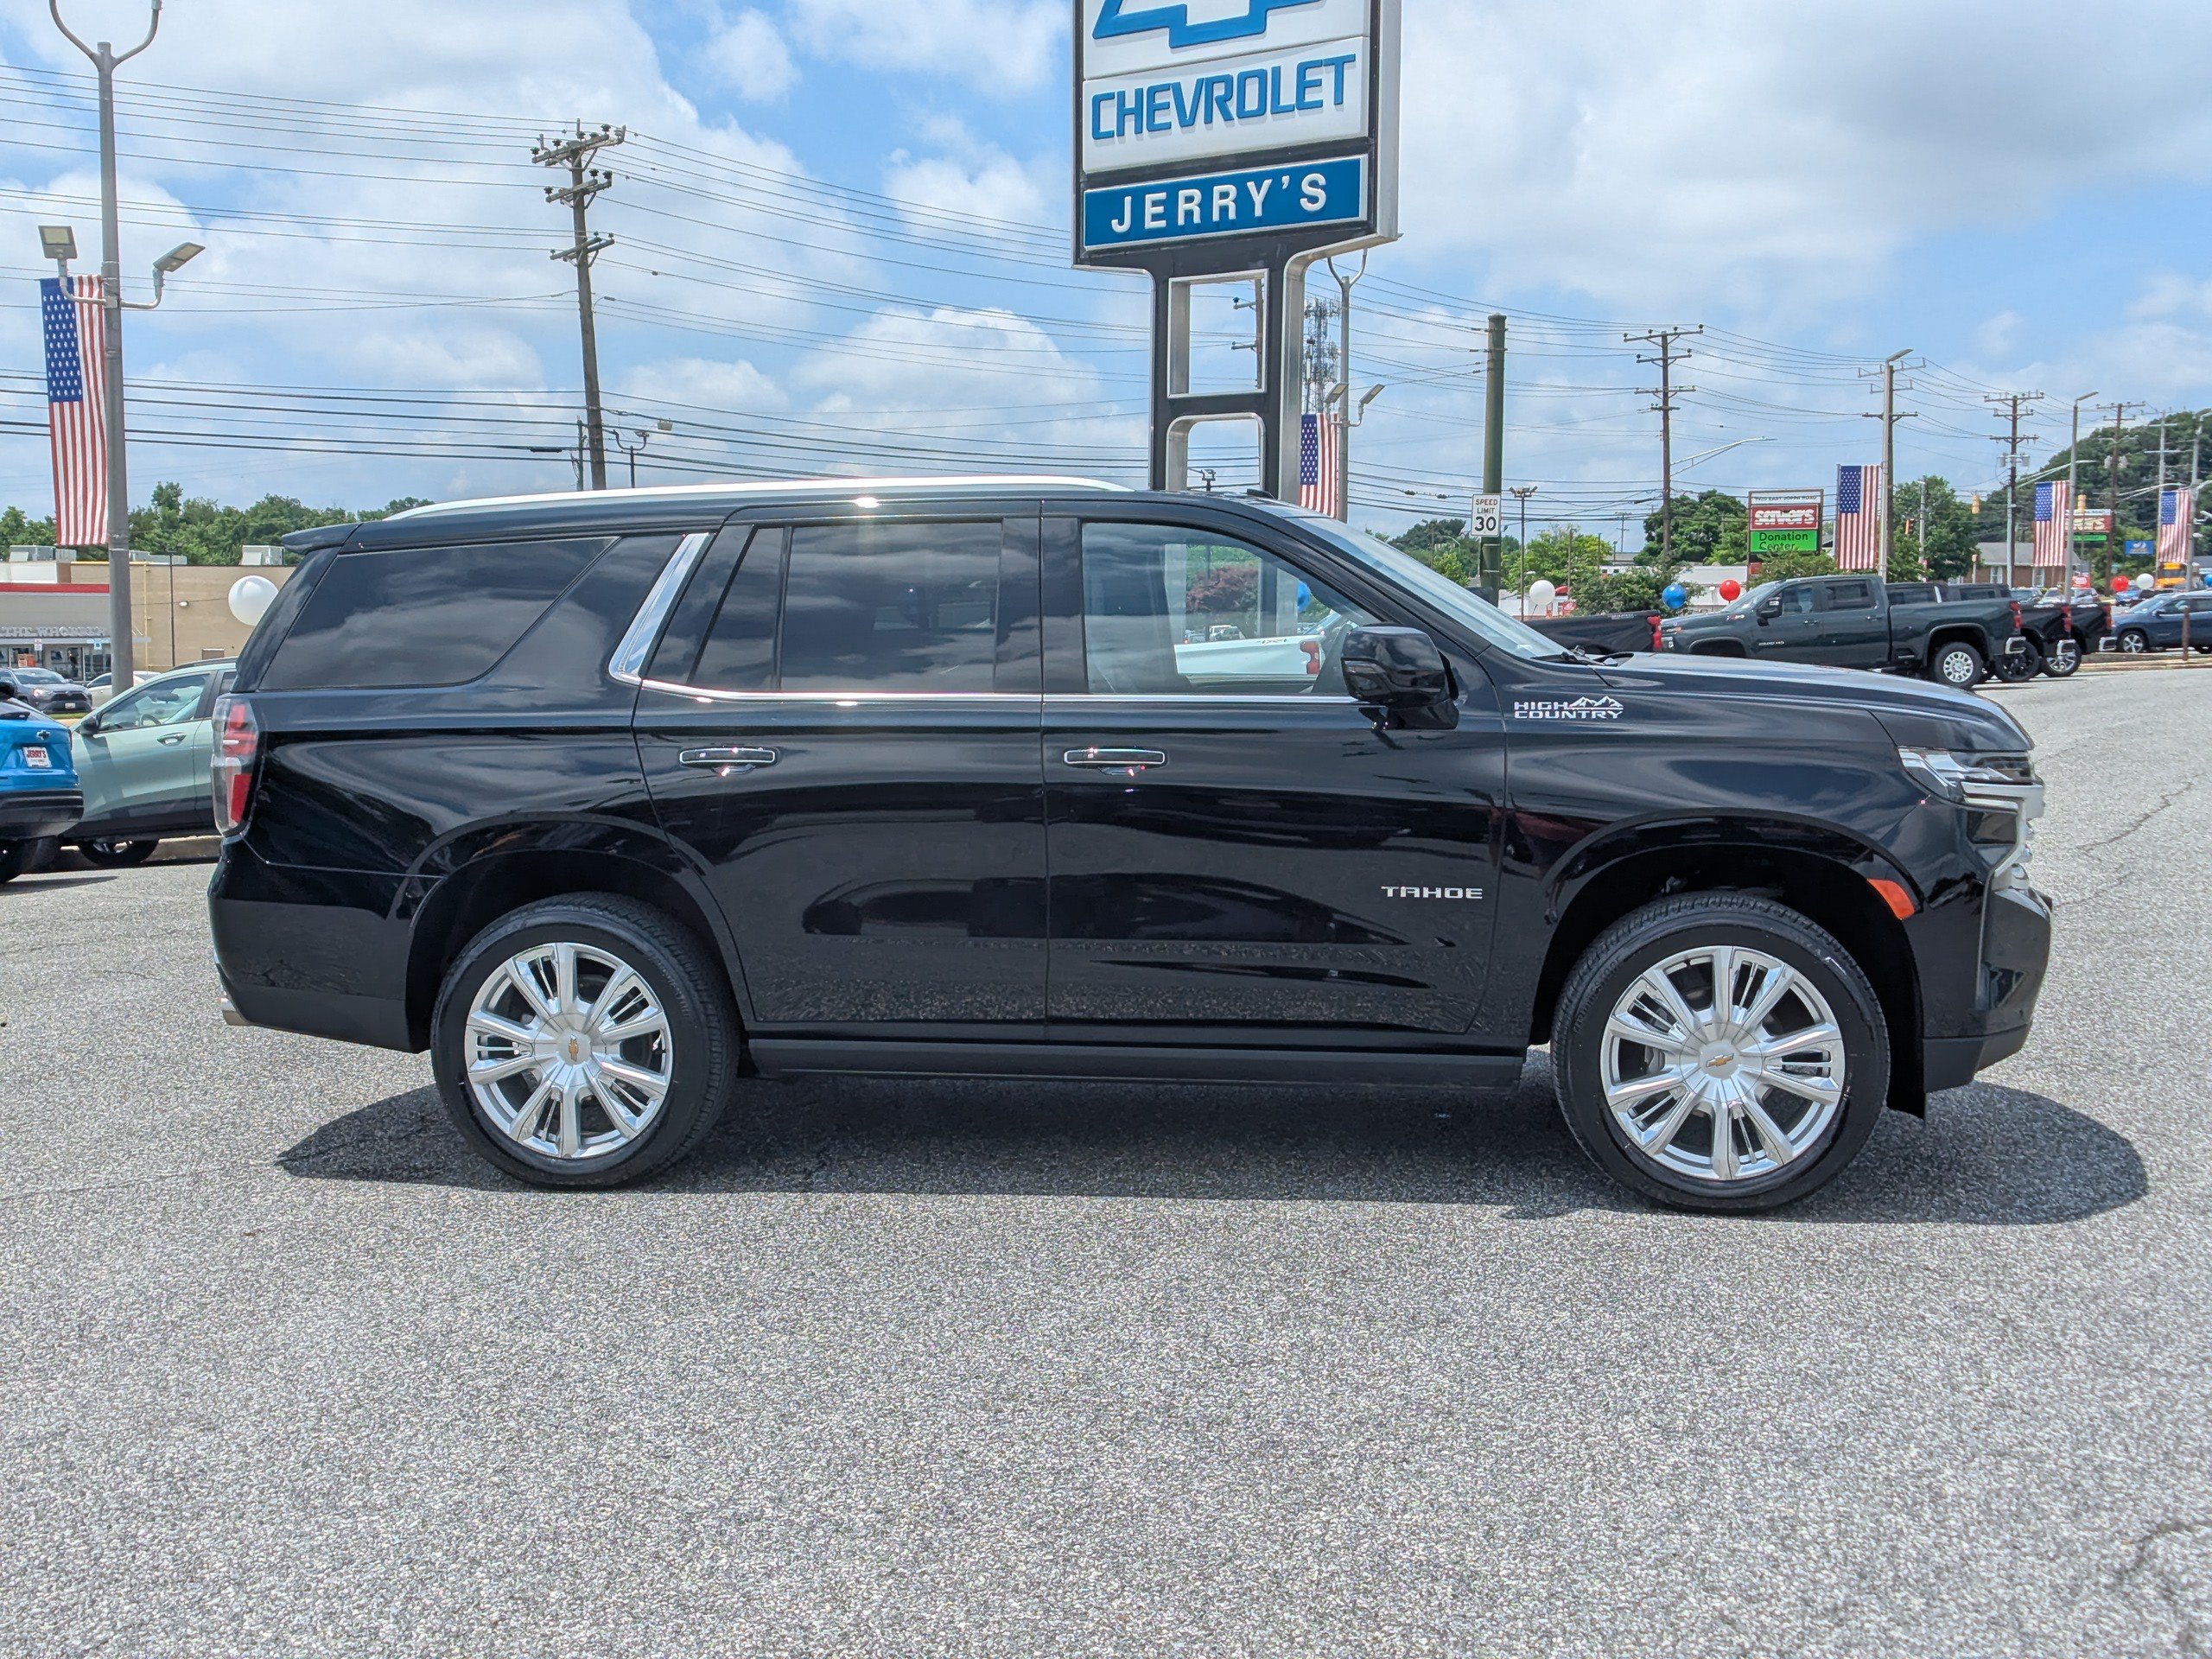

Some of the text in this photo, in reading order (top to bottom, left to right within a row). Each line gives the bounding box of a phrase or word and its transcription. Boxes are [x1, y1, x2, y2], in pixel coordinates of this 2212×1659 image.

[1091, 53, 1357, 140] CHEVROLET
[1111, 173, 1327, 234] JERRY'S
[1474, 516, 1497, 531] 30
[1758, 531, 1808, 542] Donation
[1758, 541, 1796, 550] Center
[1514, 702, 1569, 710] HIGH
[1514, 710, 1624, 719] COUNTRY
[1381, 886, 1484, 899] TAHOE
